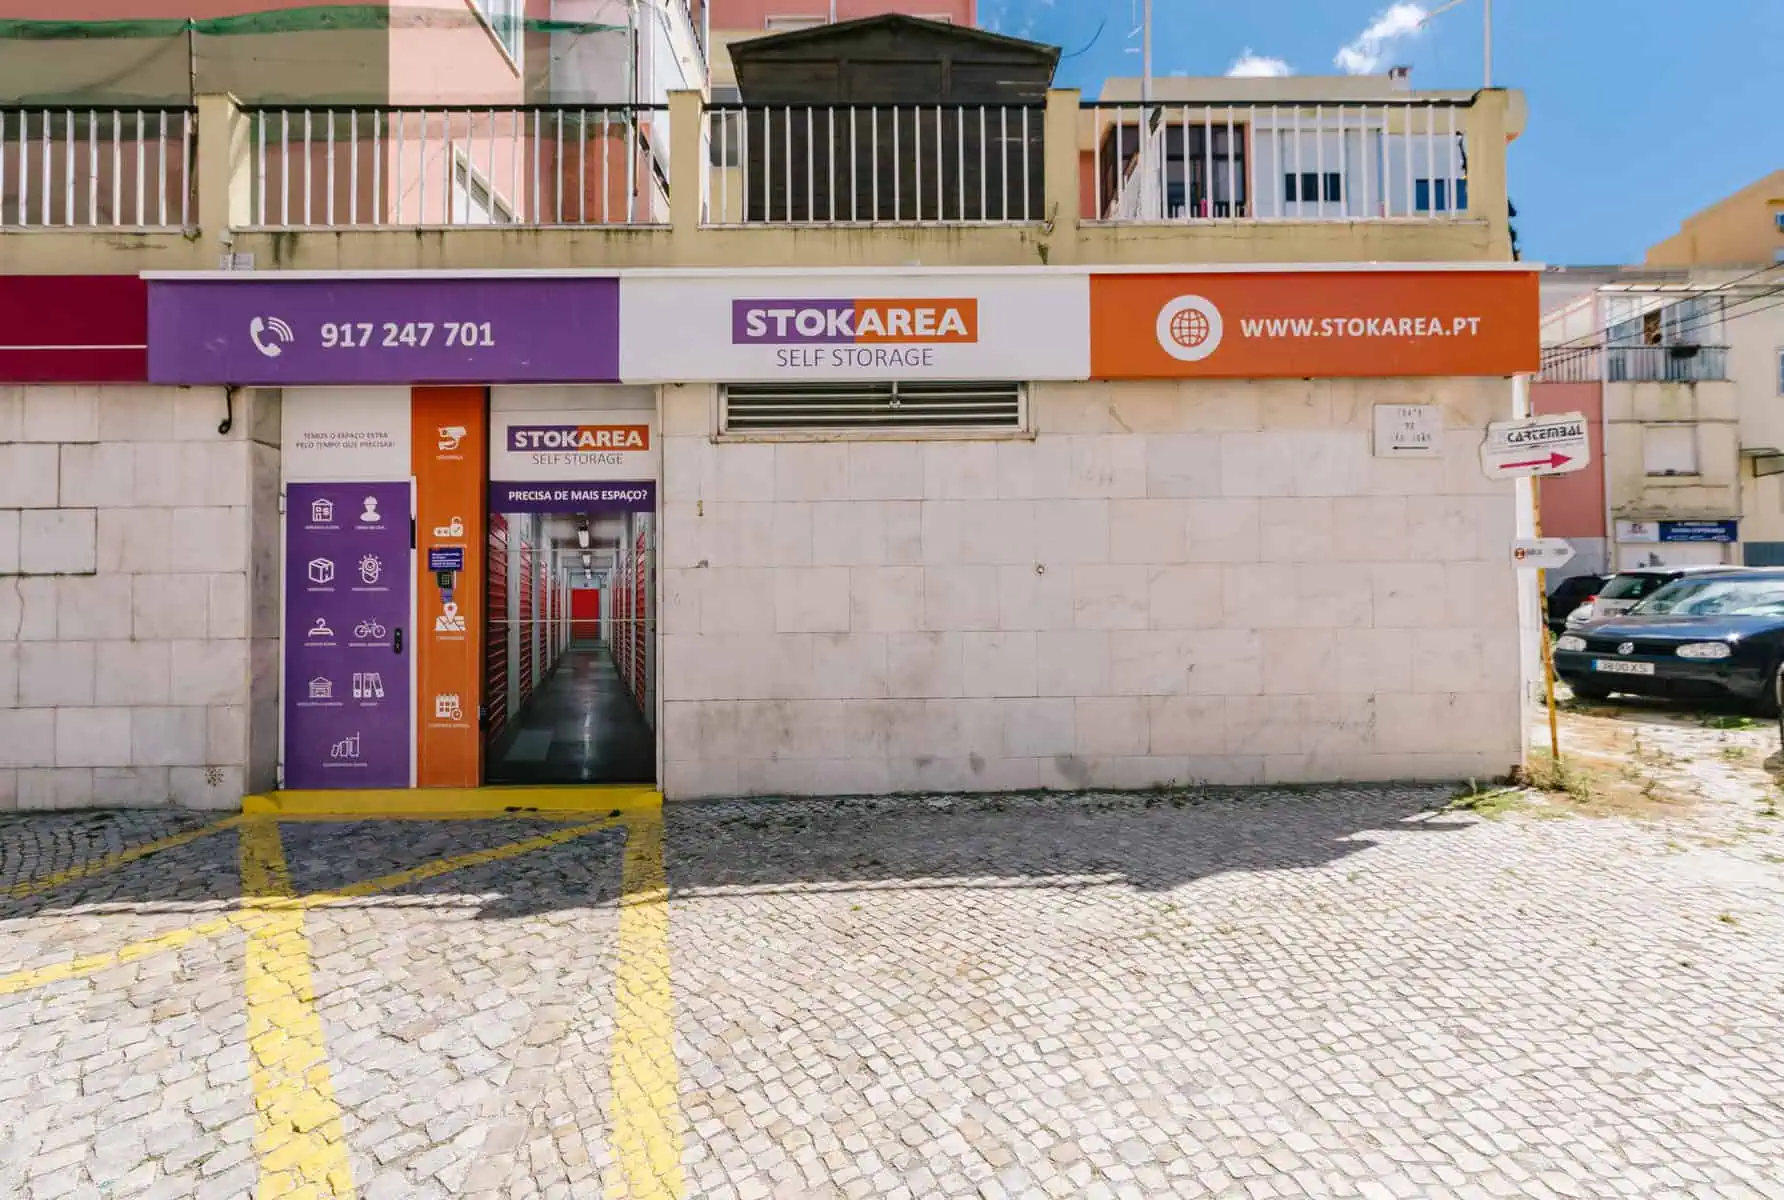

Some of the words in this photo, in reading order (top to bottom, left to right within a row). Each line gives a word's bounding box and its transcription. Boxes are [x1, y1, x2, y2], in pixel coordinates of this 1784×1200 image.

[745, 307, 969, 338] STOKAREA
[1239, 316, 1481, 338] WWW.STOKAREA.PT
[320, 322, 374, 348] 917
[381, 322, 435, 348] 247
[443, 321, 495, 347] 701
[776, 348, 826, 368] SELF
[831, 347, 934, 368] STORAGE
[514, 430, 643, 448] STOKAREA
[532, 453, 560, 465] SELF
[564, 453, 623, 465] STORAGE
[508, 491, 551, 501] PRECISA
[554, 491, 568, 501] DE
[571, 491, 599, 501] MAIS
[601, 489, 647, 502] ESPAÇO?
